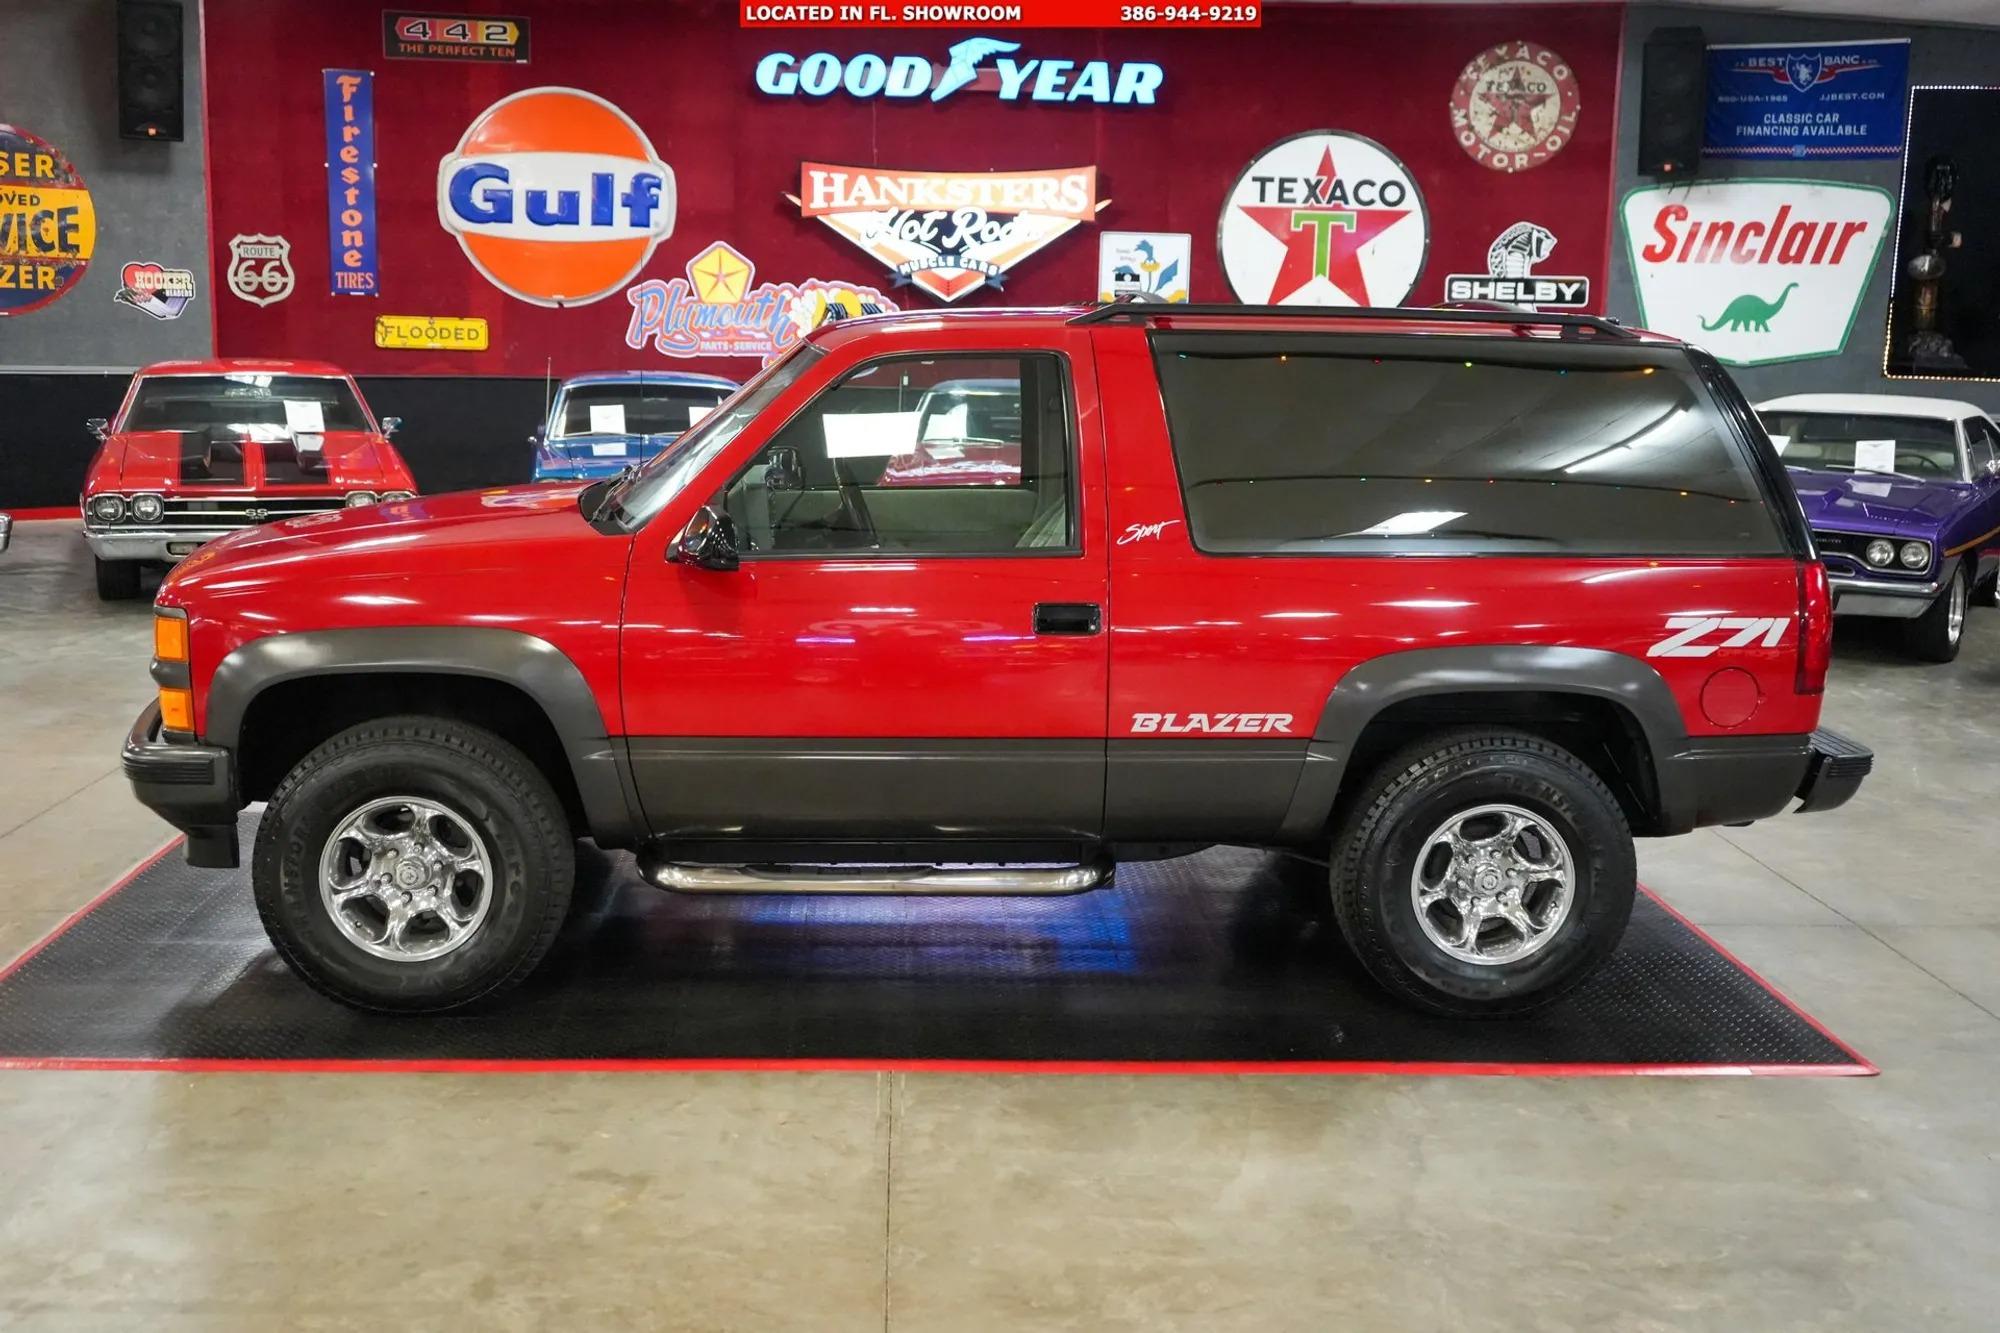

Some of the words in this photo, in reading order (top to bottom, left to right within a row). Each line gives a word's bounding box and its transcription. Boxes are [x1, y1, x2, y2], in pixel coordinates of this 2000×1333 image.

[404, 19, 508, 42] 442
[400, 44, 424, 53] THE
[429, 45, 484, 57] PERFECT
[492, 47, 515, 57] TEN
[1748, 57, 1785, 67] BEST
[1824, 55, 1860, 65] BANC
[756, 52, 932, 97] GOOD
[995, 57, 1163, 104] YEAR
[1763, 113, 1812, 124] CLASSIC
[1816, 113, 1839, 124] CAR
[1736, 125, 1799, 136] FINANCING
[1802, 124, 1867, 136] AVAILABLE
[336, 75, 364, 268] Firestone
[449, 162, 662, 228] Gulf
[809, 170, 1090, 213] HANKSTERS
[1252, 176, 1406, 207] TEXACO
[1642, 204, 1868, 266] Sinclair
[243, 247, 275, 257] ROUTE
[899, 256, 955, 275] MUSCLE
[959, 258, 998, 275] CARS
[134, 271, 192, 289] HOOKER
[237, 259, 282, 293] 66
[335, 271, 375, 290] TIRES
[1451, 281, 1582, 301] SHELBY
[634, 285, 795, 349] Plymouth
[384, 325, 480, 341] FLOODED
[700, 341, 729, 351] PARTS
[733, 341, 772, 350] SERVICE
[245, 508, 268, 516] SS
[1117, 520, 1181, 545] Sport
[1646, 617, 1790, 657] Z71
[1131, 713, 1293, 732] BLAZER
